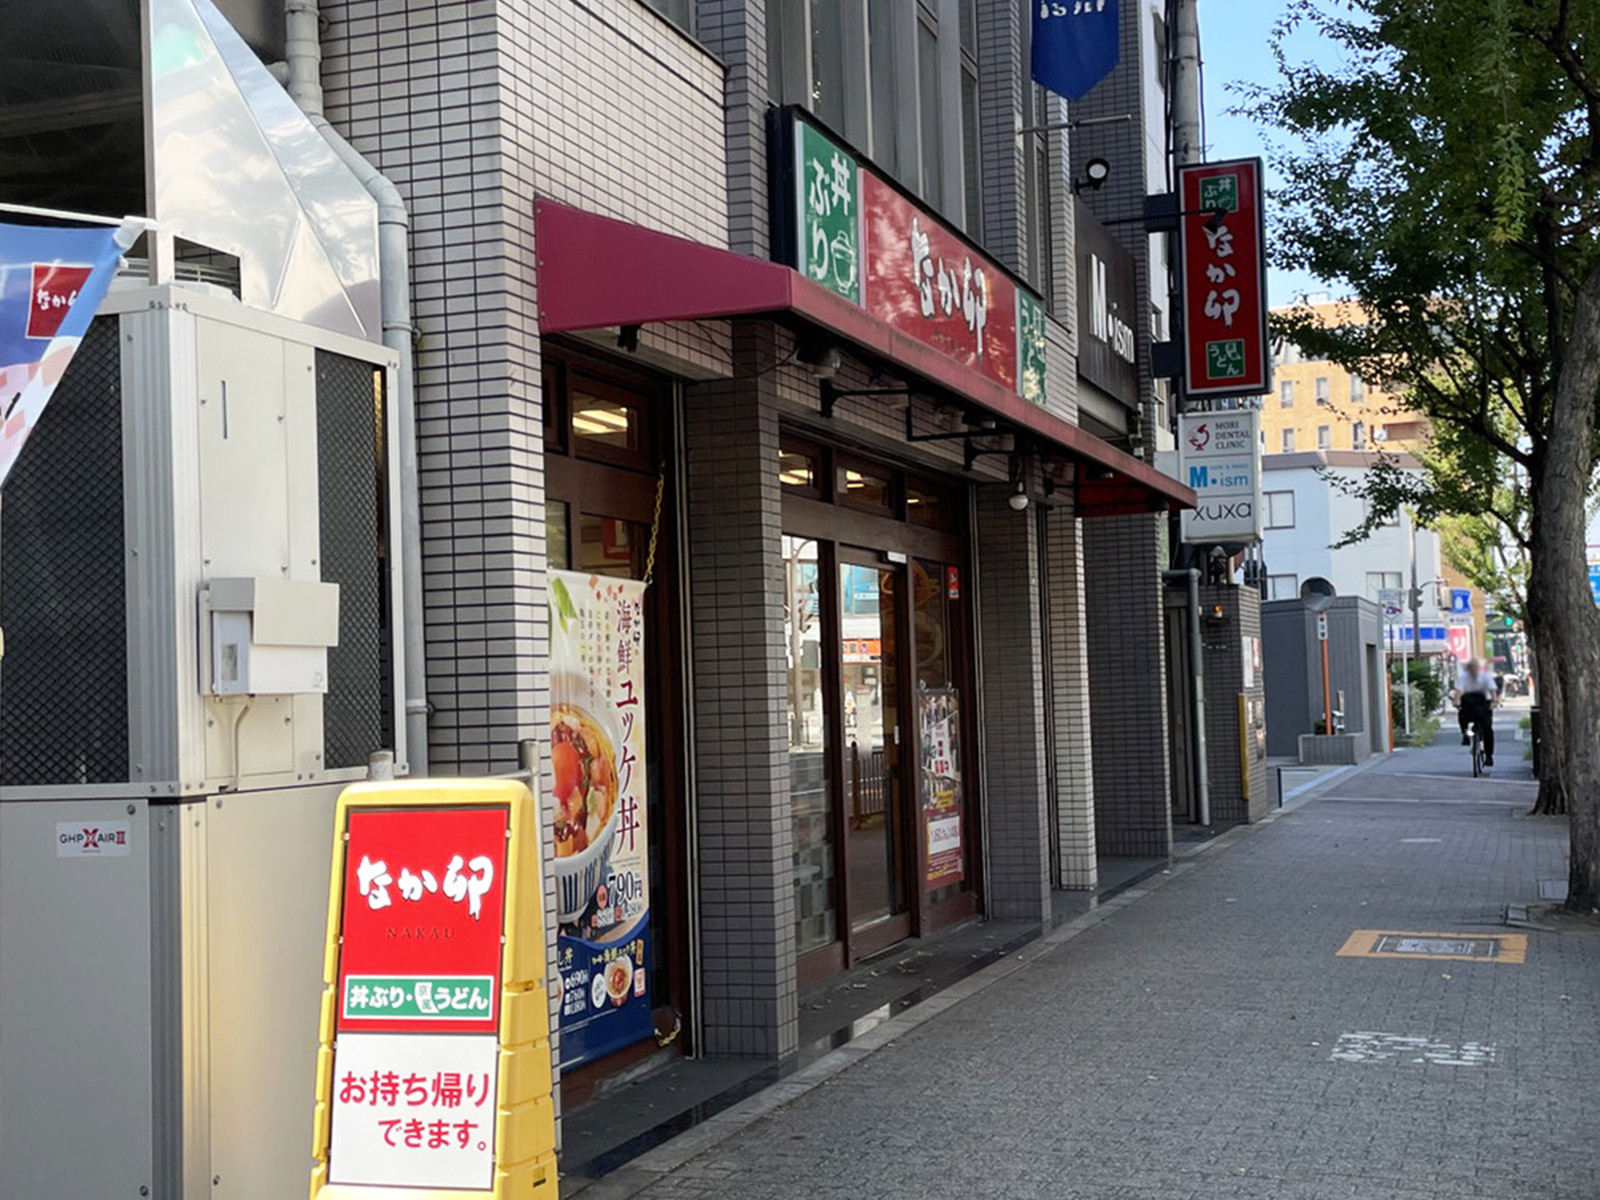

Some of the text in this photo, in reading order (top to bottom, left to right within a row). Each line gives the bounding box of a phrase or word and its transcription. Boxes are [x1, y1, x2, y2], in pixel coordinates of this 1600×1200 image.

[911, 216, 987, 366] なか卯
[1204, 225, 1240, 328] なか卯
[1215, 421, 1239, 430] MORI
[1215, 431, 1251, 440] DENTAL
[1215, 441, 1246, 450] CLINIC
[1192, 502, 1252, 521] xuxa
[616, 599, 640, 855] 海鮮ユッケ丼
[357, 855, 494, 921] なか卯
[386, 927, 455, 940] NAKAU
[339, 1070, 489, 1108] お持ち帰り
[378, 1118, 486, 1151] できます。
